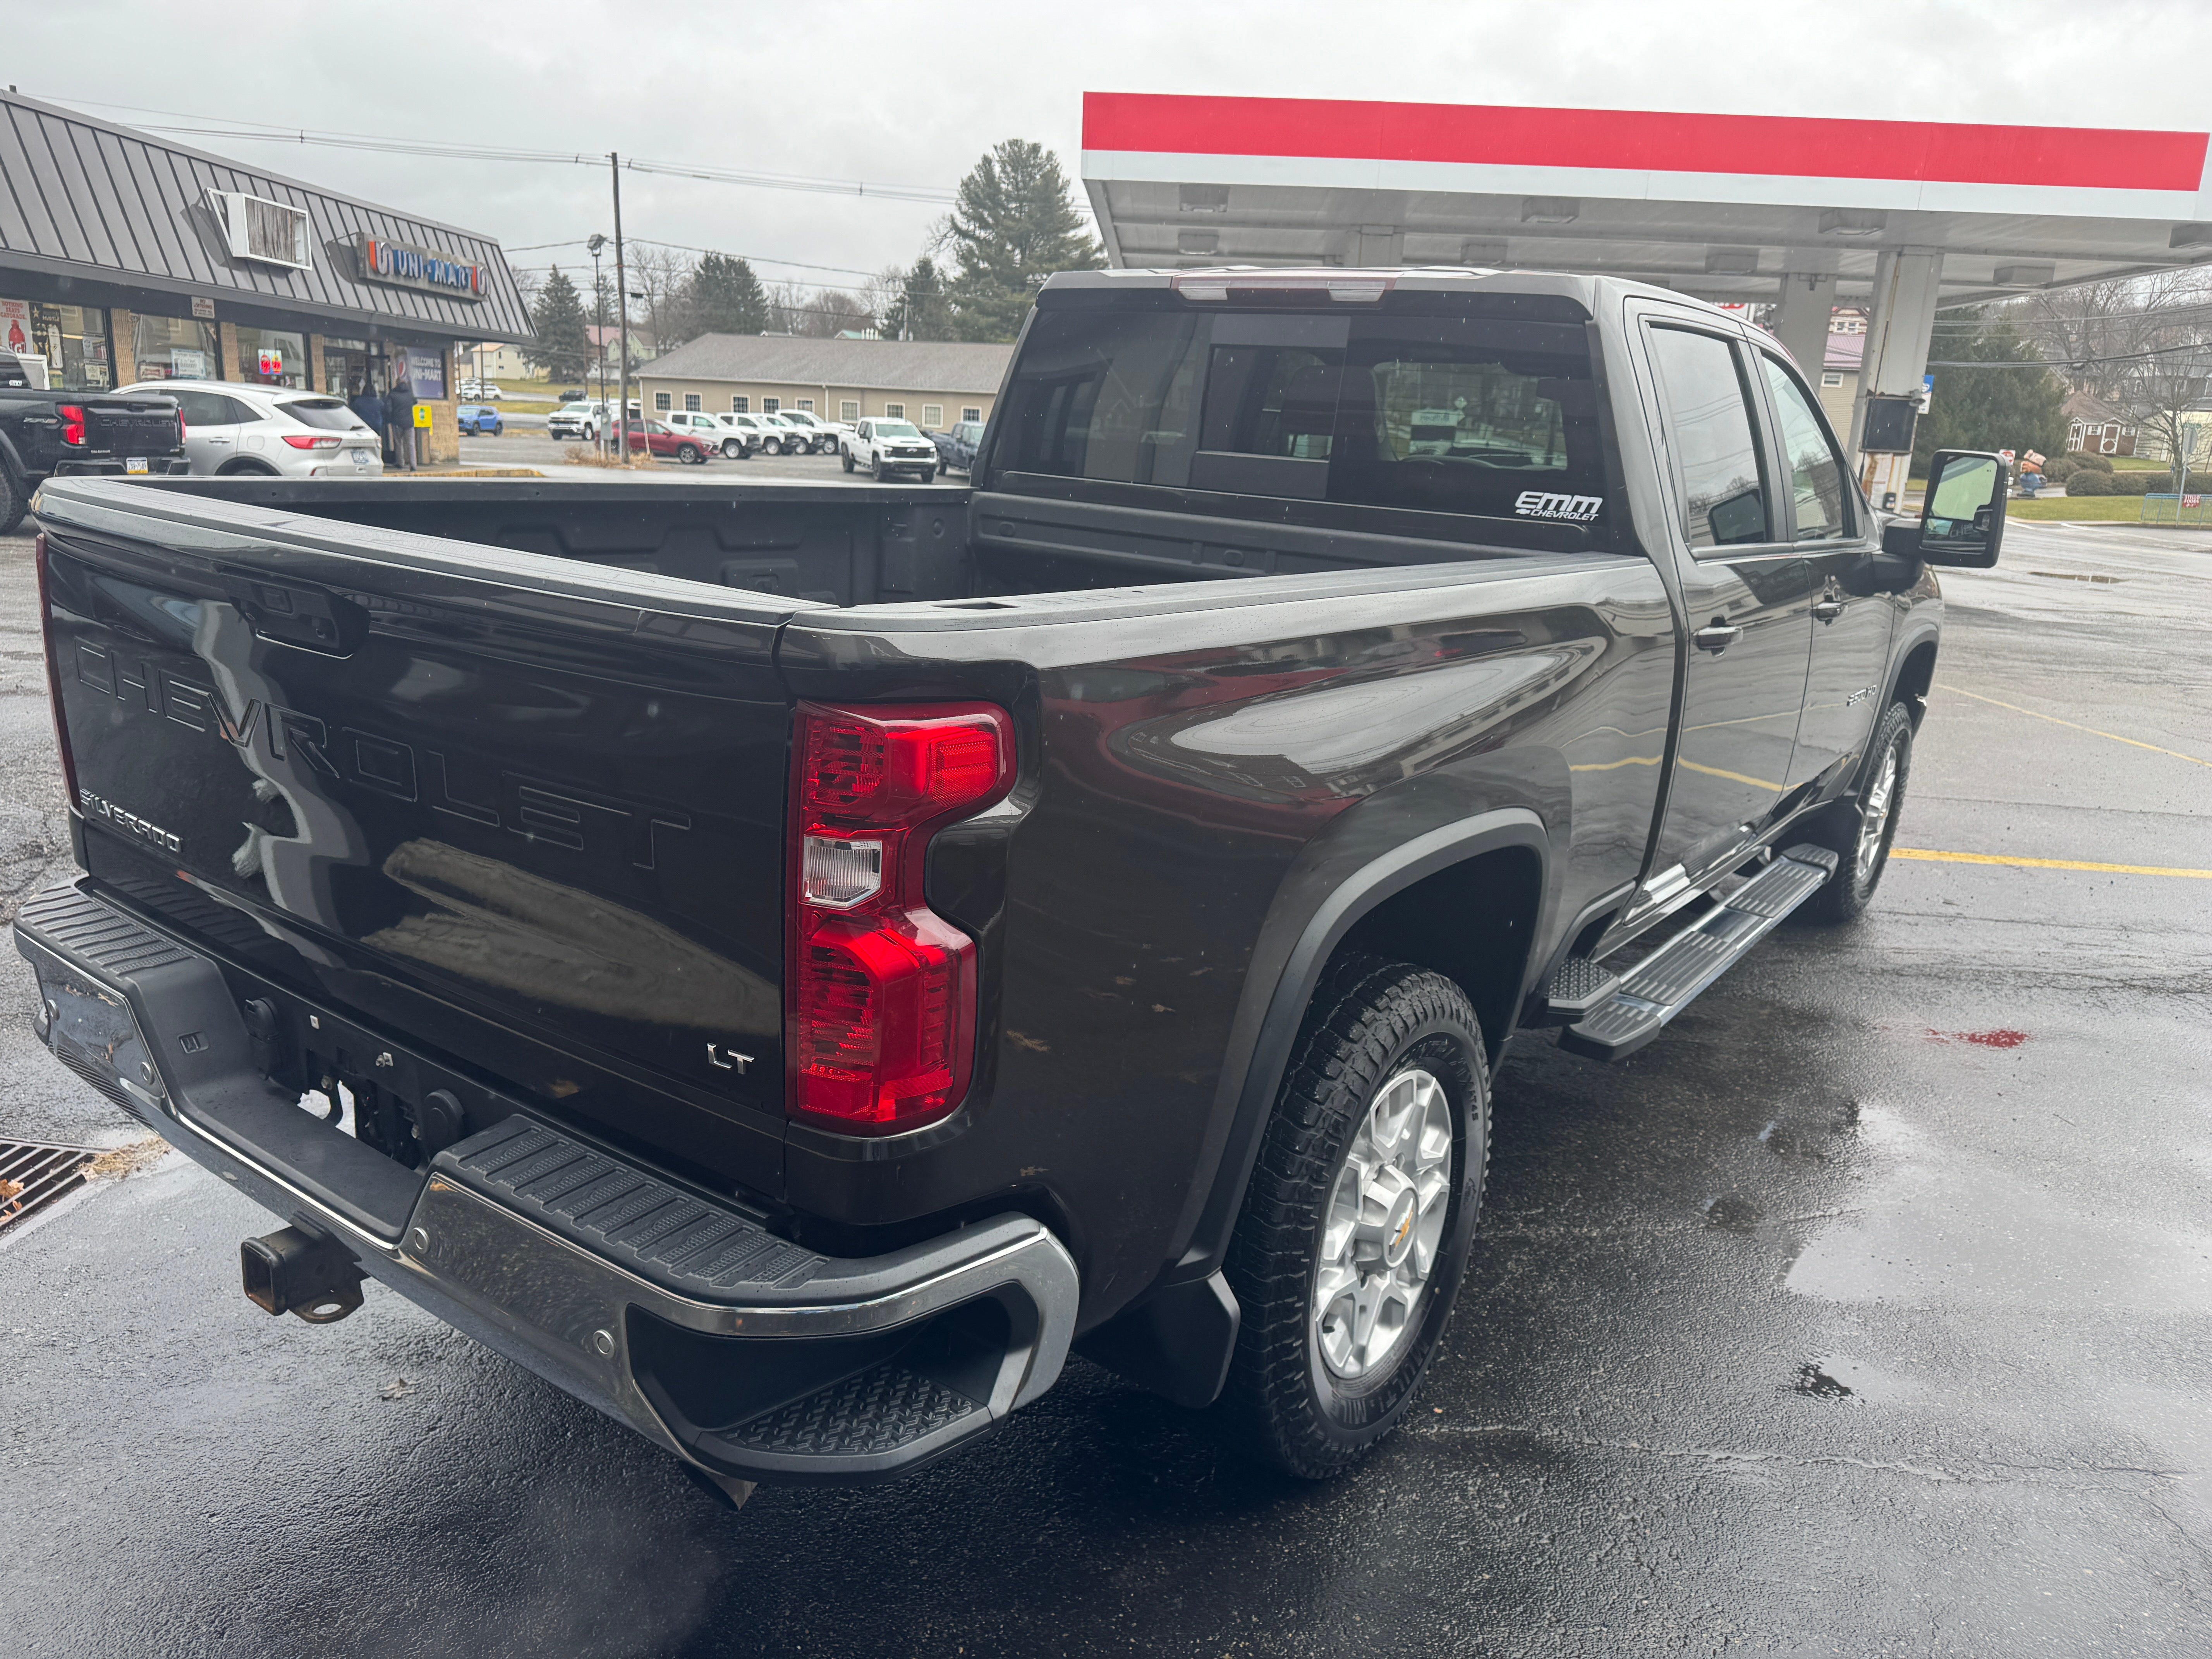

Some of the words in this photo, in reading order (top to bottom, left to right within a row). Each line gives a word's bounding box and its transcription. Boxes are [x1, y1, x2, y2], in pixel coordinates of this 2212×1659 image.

[392, 249, 472, 289] UNI-MART
[410, 356, 434, 368] WELCOME
[434, 358, 441, 368] TO
[101, 419, 174, 427] CHEVROLET
[1530, 509, 1599, 521] CHEVROLET
[74, 635, 691, 869] CHEVROLET
[80, 788, 183, 853] SILVERADO
[707, 1042, 755, 1075] LT
